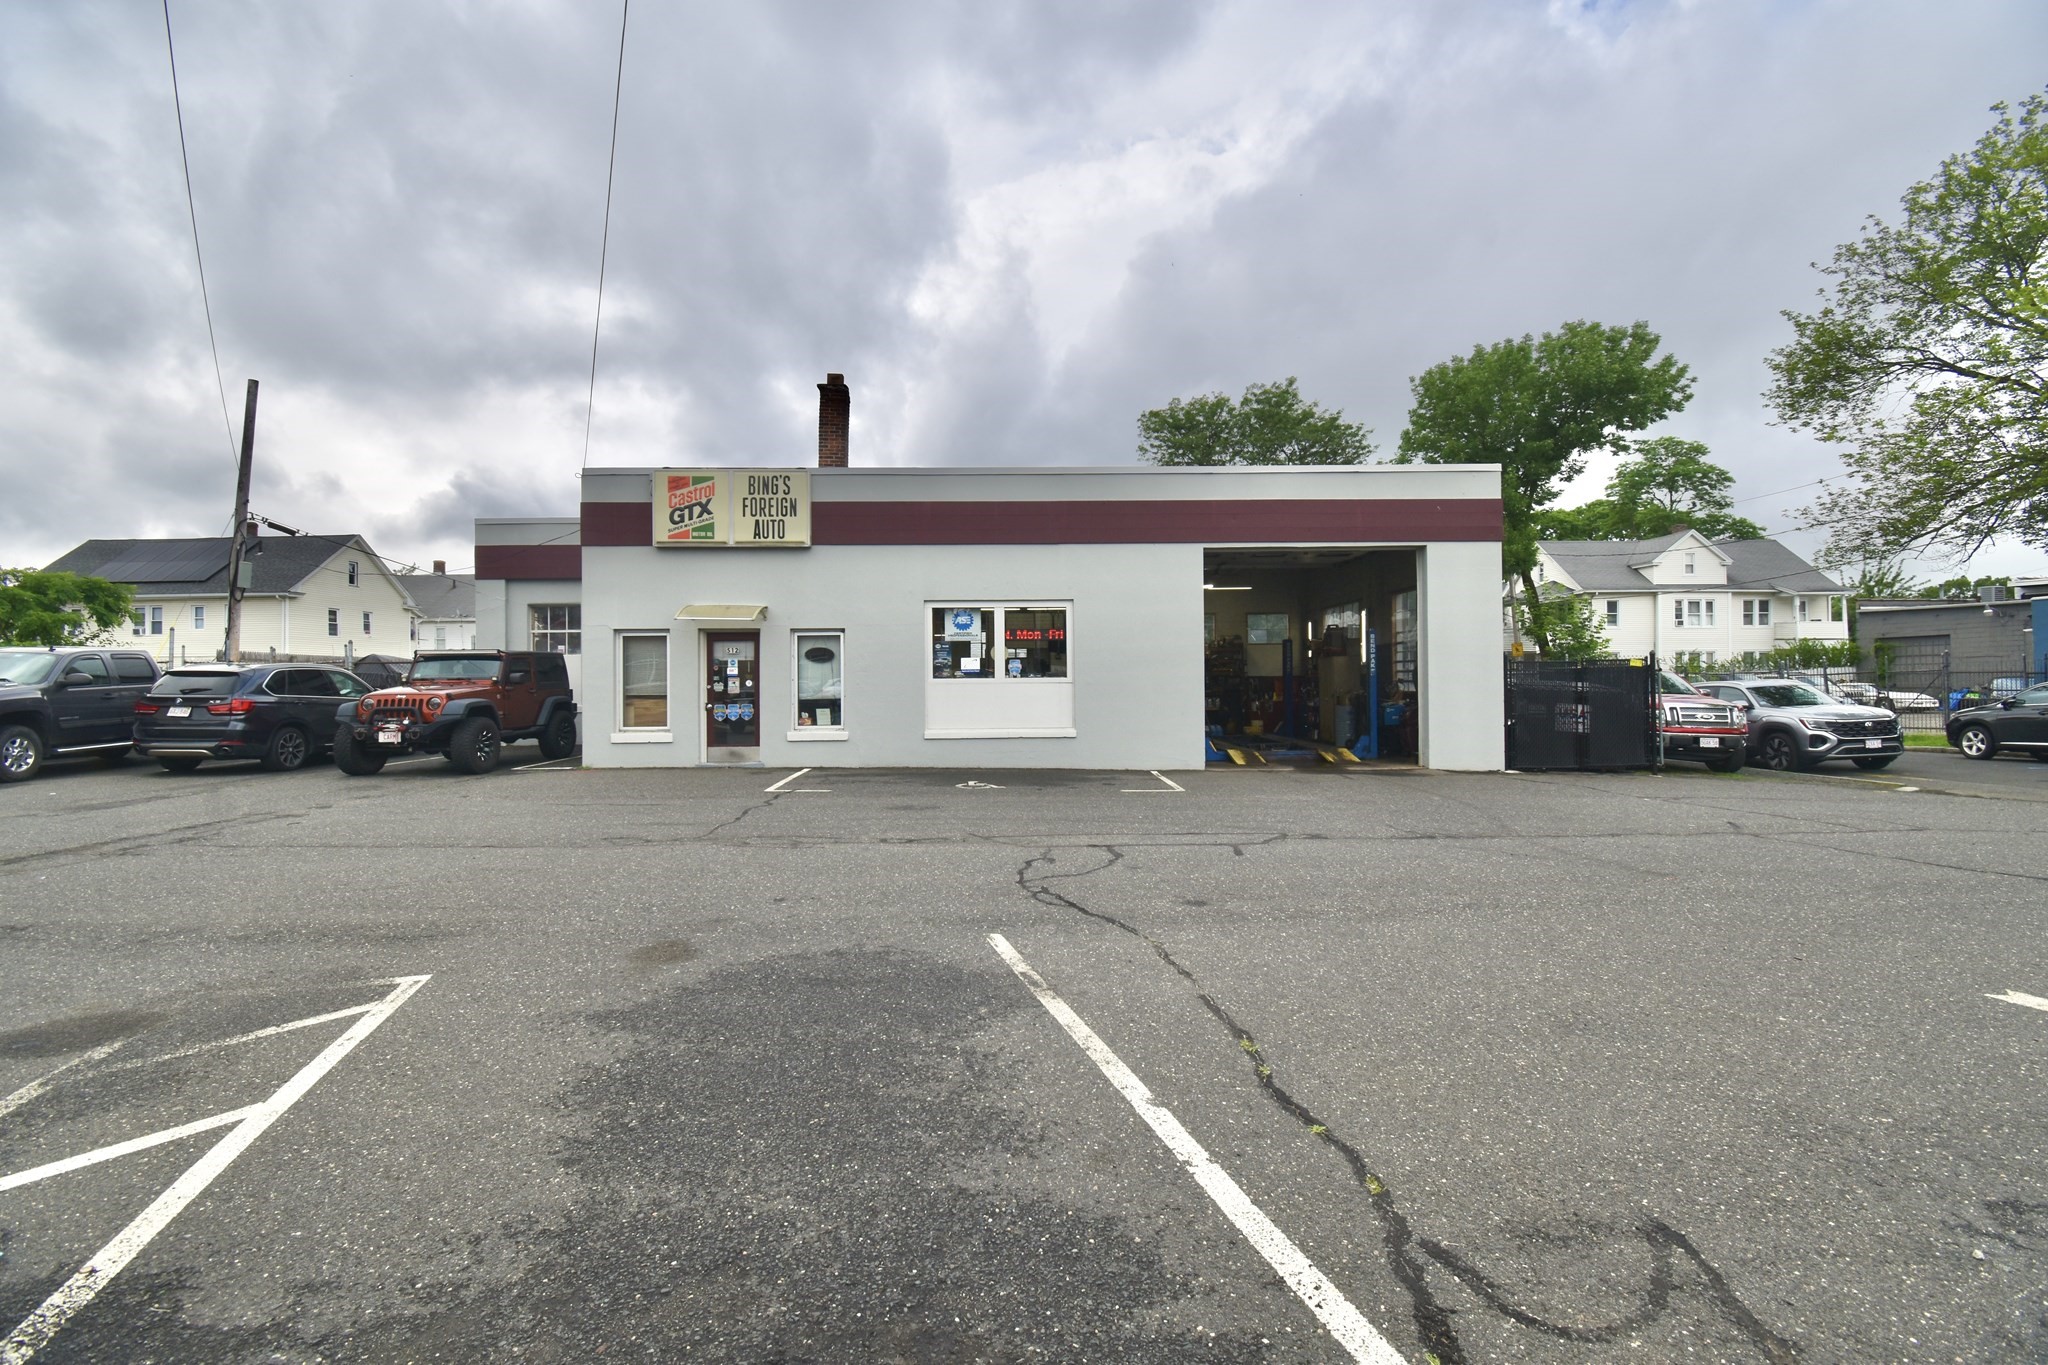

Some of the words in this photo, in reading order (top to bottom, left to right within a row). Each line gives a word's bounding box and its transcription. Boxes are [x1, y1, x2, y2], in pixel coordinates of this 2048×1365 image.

[668, 481, 715, 509] Castrol
[748, 474, 791, 496] BING'S
[669, 497, 714, 526] GTX
[742, 497, 797, 518] FOREIGN
[667, 525, 683, 533] SUPER
[753, 519, 786, 540] AUTO
[955, 616, 971, 625] ASE
[1016, 629, 1042, 640] Mon
